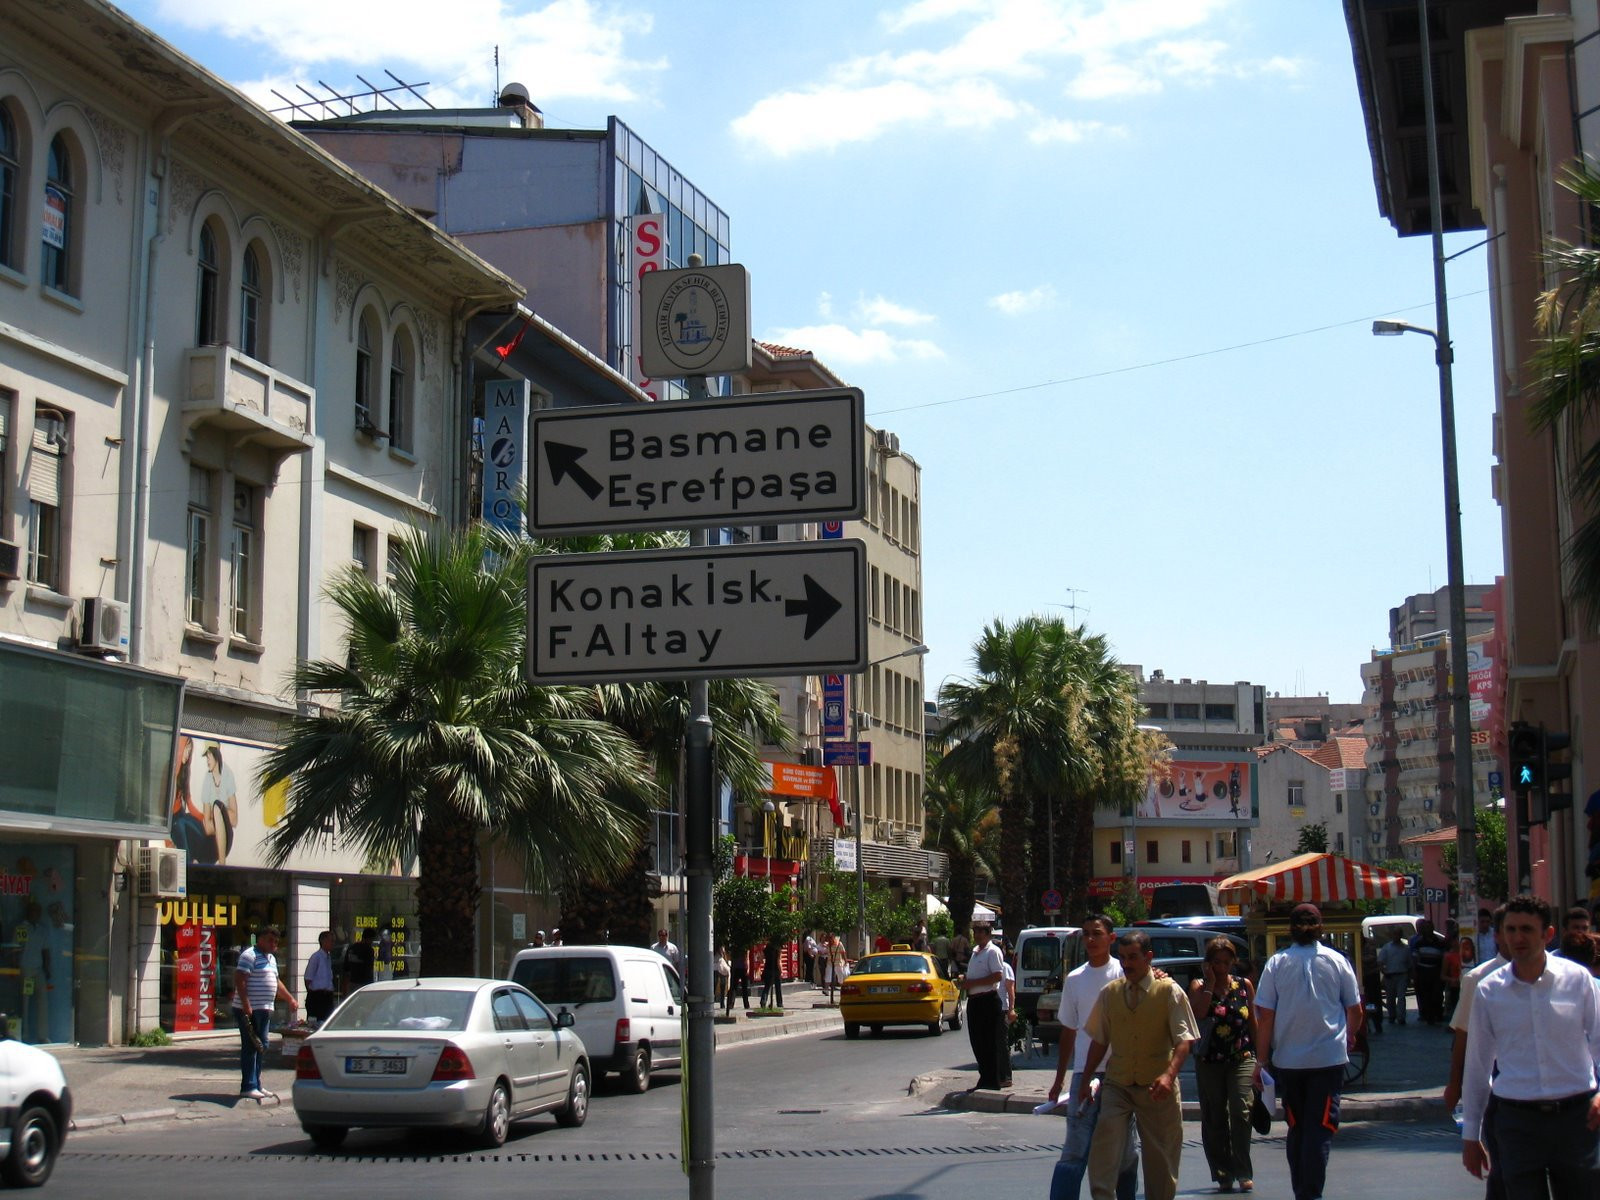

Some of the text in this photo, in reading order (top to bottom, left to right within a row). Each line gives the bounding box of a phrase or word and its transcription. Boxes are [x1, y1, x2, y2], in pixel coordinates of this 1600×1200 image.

[609, 423, 832, 463] Basmane
[608, 467, 838, 511] Eşrefpaşa
[550, 562, 783, 613] Konak İsk.
[549, 621, 722, 663] F.Altay
[157, 895, 241, 926] OUTLET
[181, 962, 194, 972] sale
[180, 996, 193, 1006] sale
